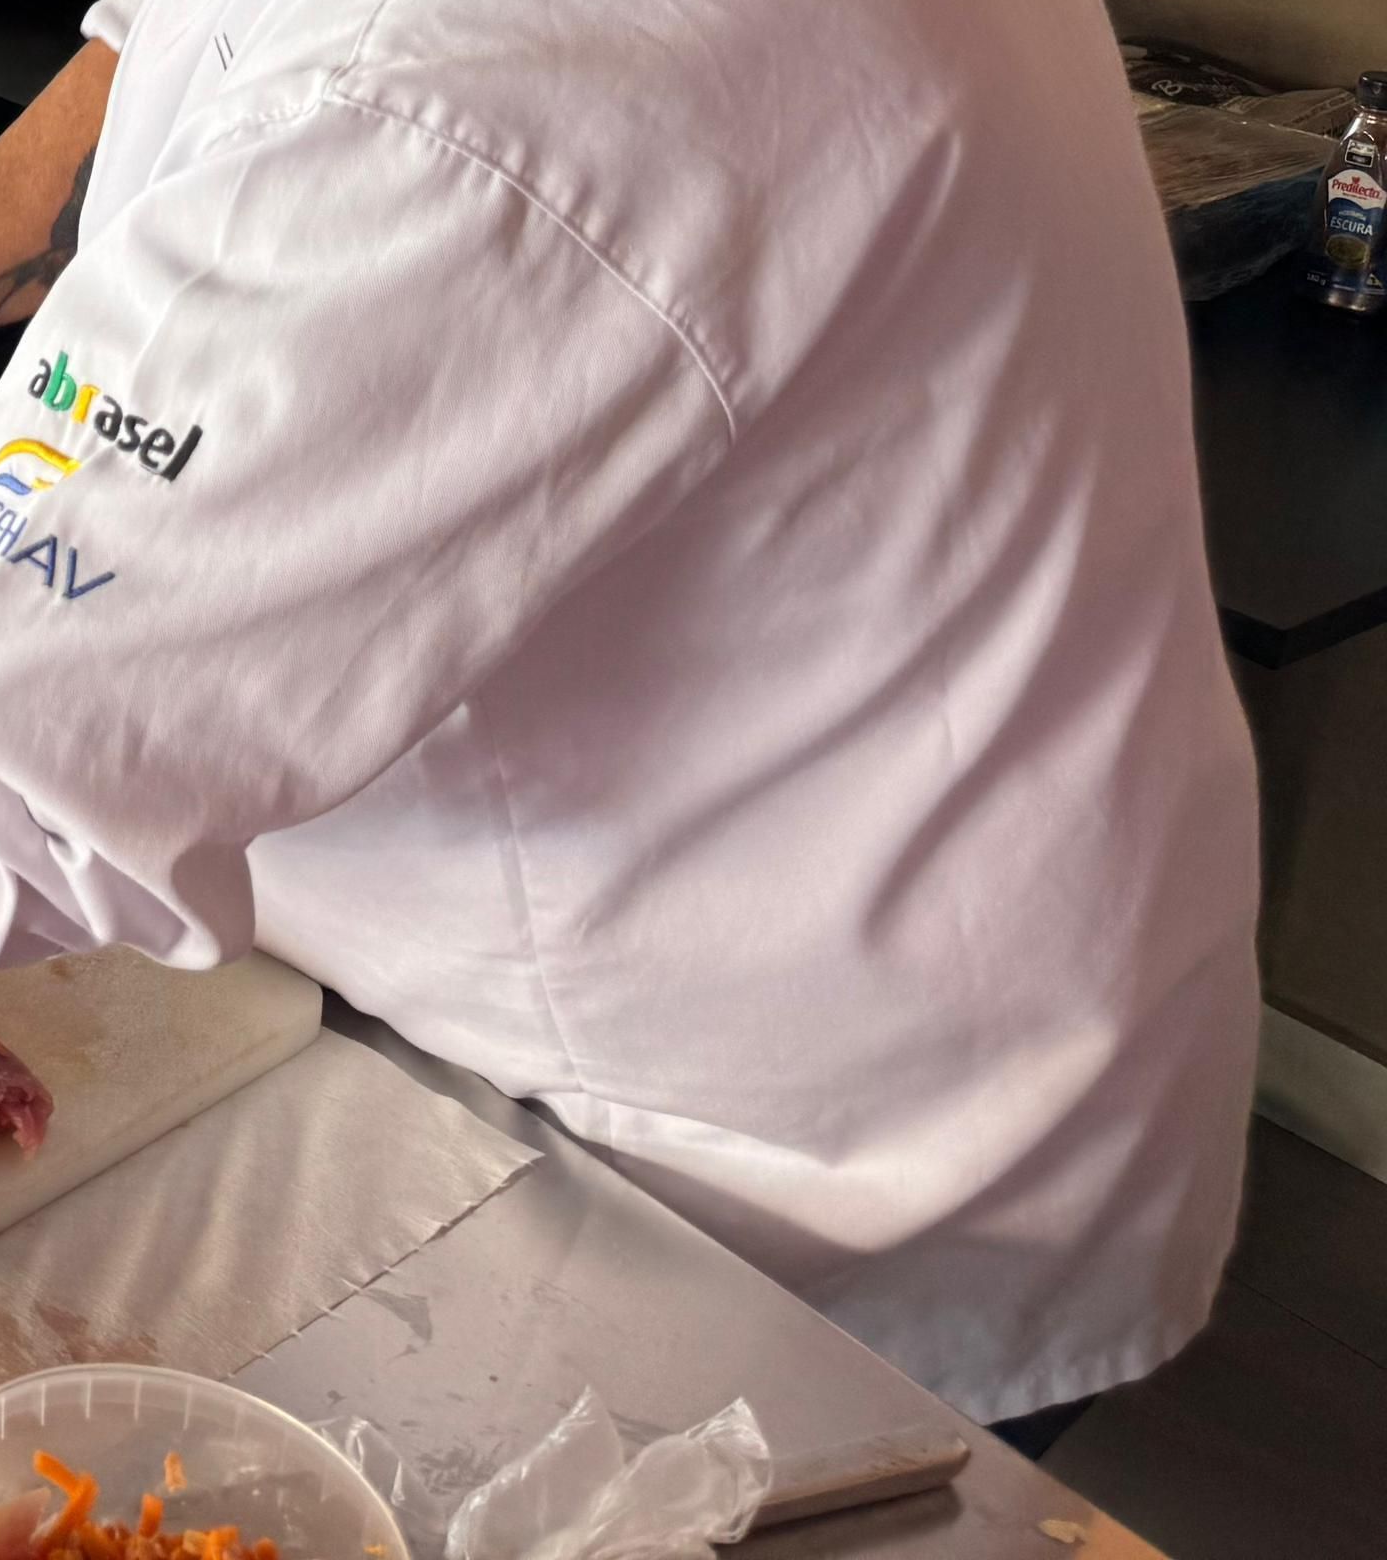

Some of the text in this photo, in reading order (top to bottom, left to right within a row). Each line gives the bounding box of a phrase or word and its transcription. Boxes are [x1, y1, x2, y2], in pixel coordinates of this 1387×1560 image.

[1332, 178, 1381, 198] Predilecta
[1330, 216, 1373, 236] ESCURA
[28, 350, 203, 482] abrasel
